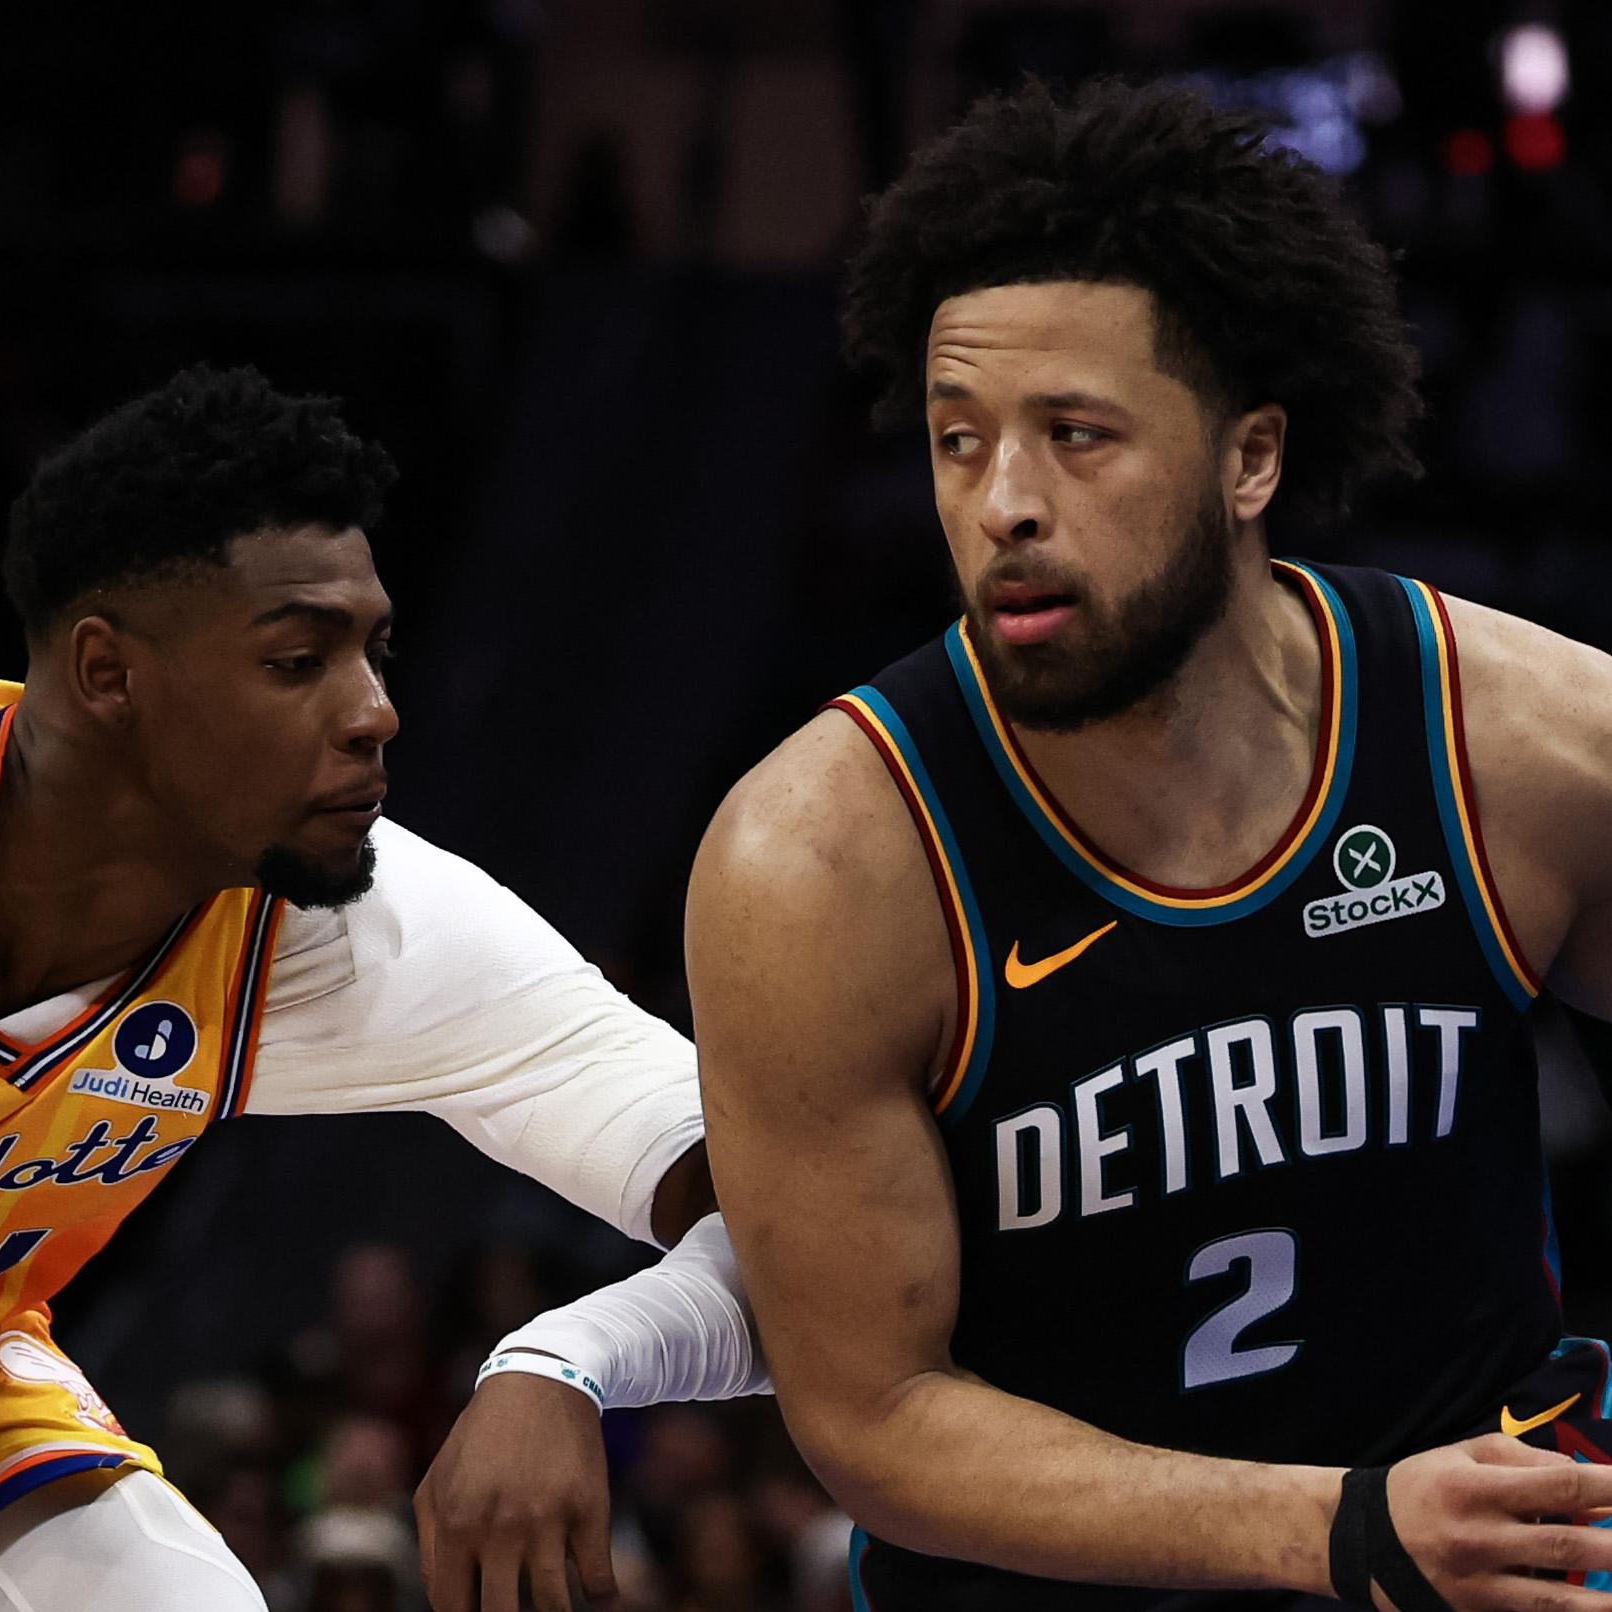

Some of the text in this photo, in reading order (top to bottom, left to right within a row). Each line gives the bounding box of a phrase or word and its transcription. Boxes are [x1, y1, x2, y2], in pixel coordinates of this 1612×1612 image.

[1306, 876, 1441, 931] StockX
[73, 1072, 205, 1112] Judi Health
[993, 1003, 1480, 1232] DETROIT
[1183, 1227, 1302, 1391] 2
